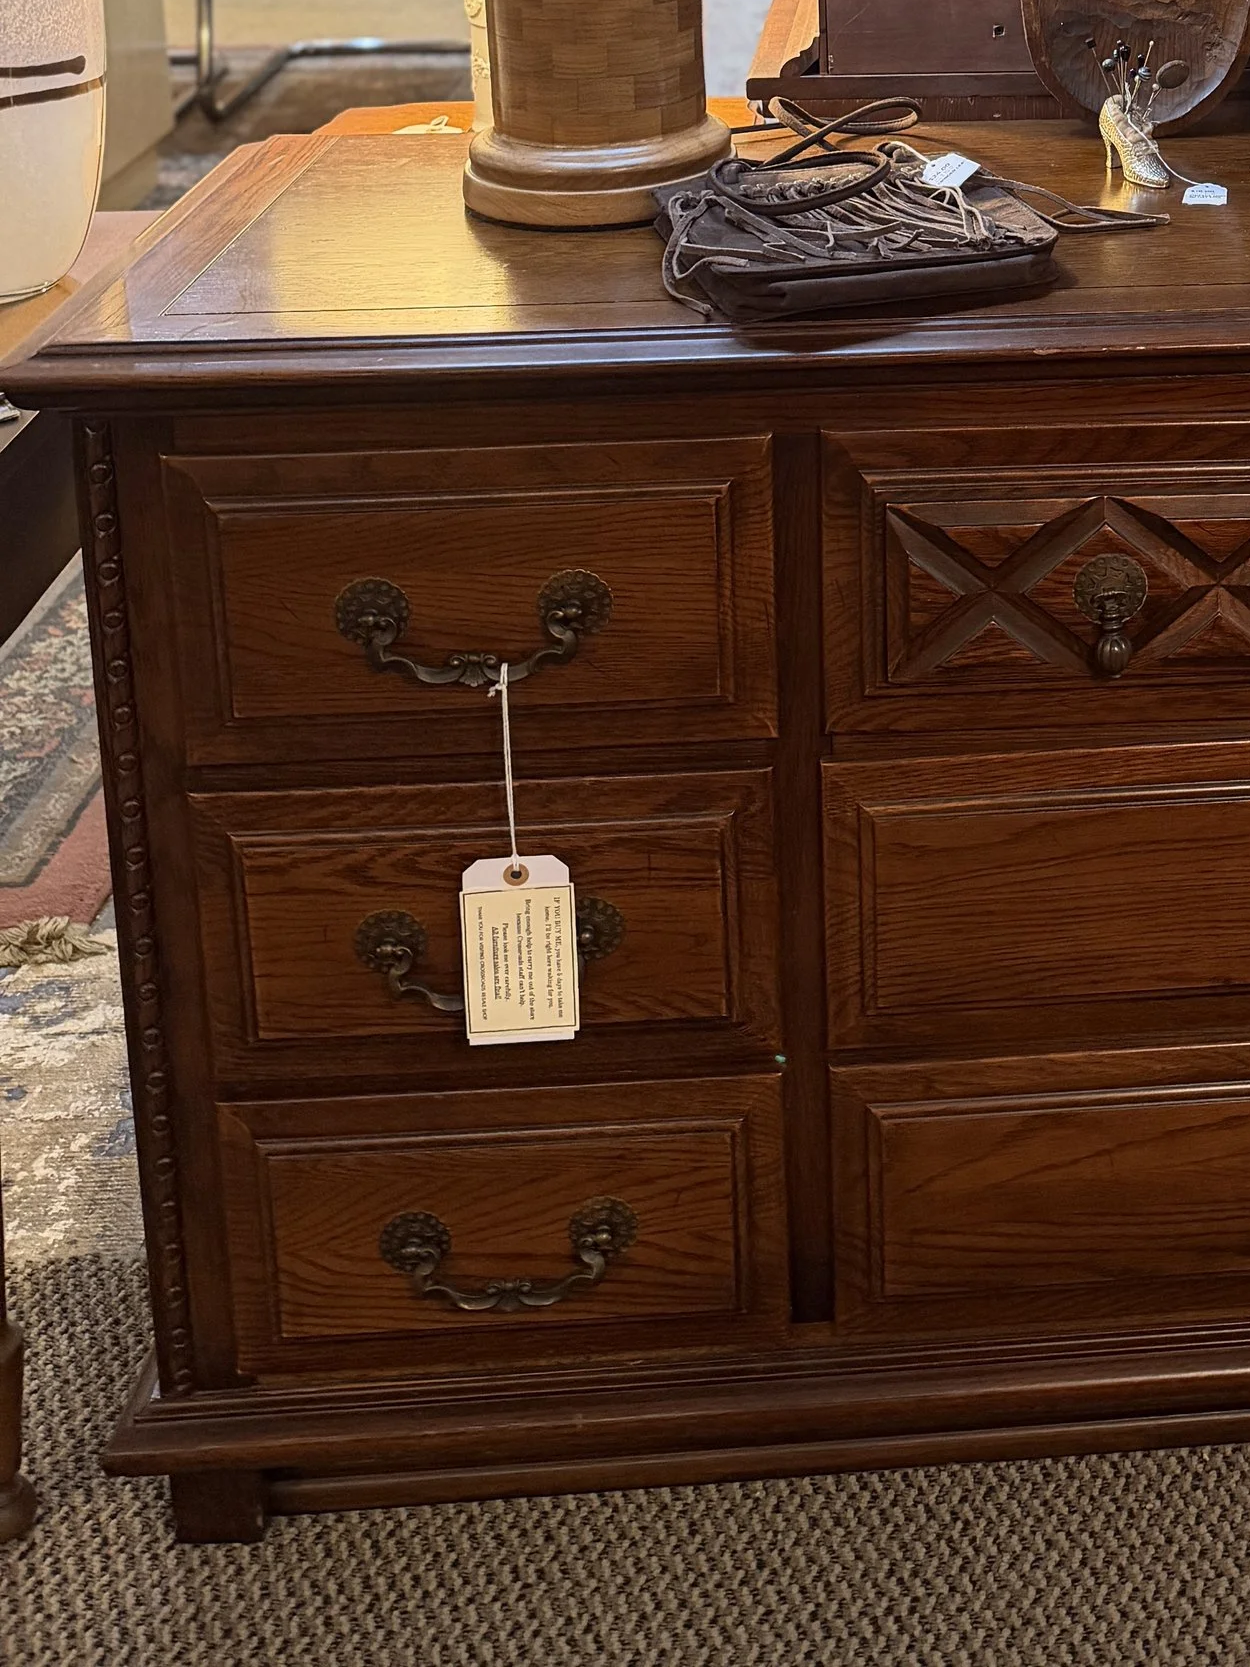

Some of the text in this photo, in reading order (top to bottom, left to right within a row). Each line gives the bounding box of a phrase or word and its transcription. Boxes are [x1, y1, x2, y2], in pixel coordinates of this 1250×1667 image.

[525, 915, 533, 936] enough
[493, 936, 501, 960] furniture
[504, 954, 509, 962] me
[528, 972, 533, 980] me
